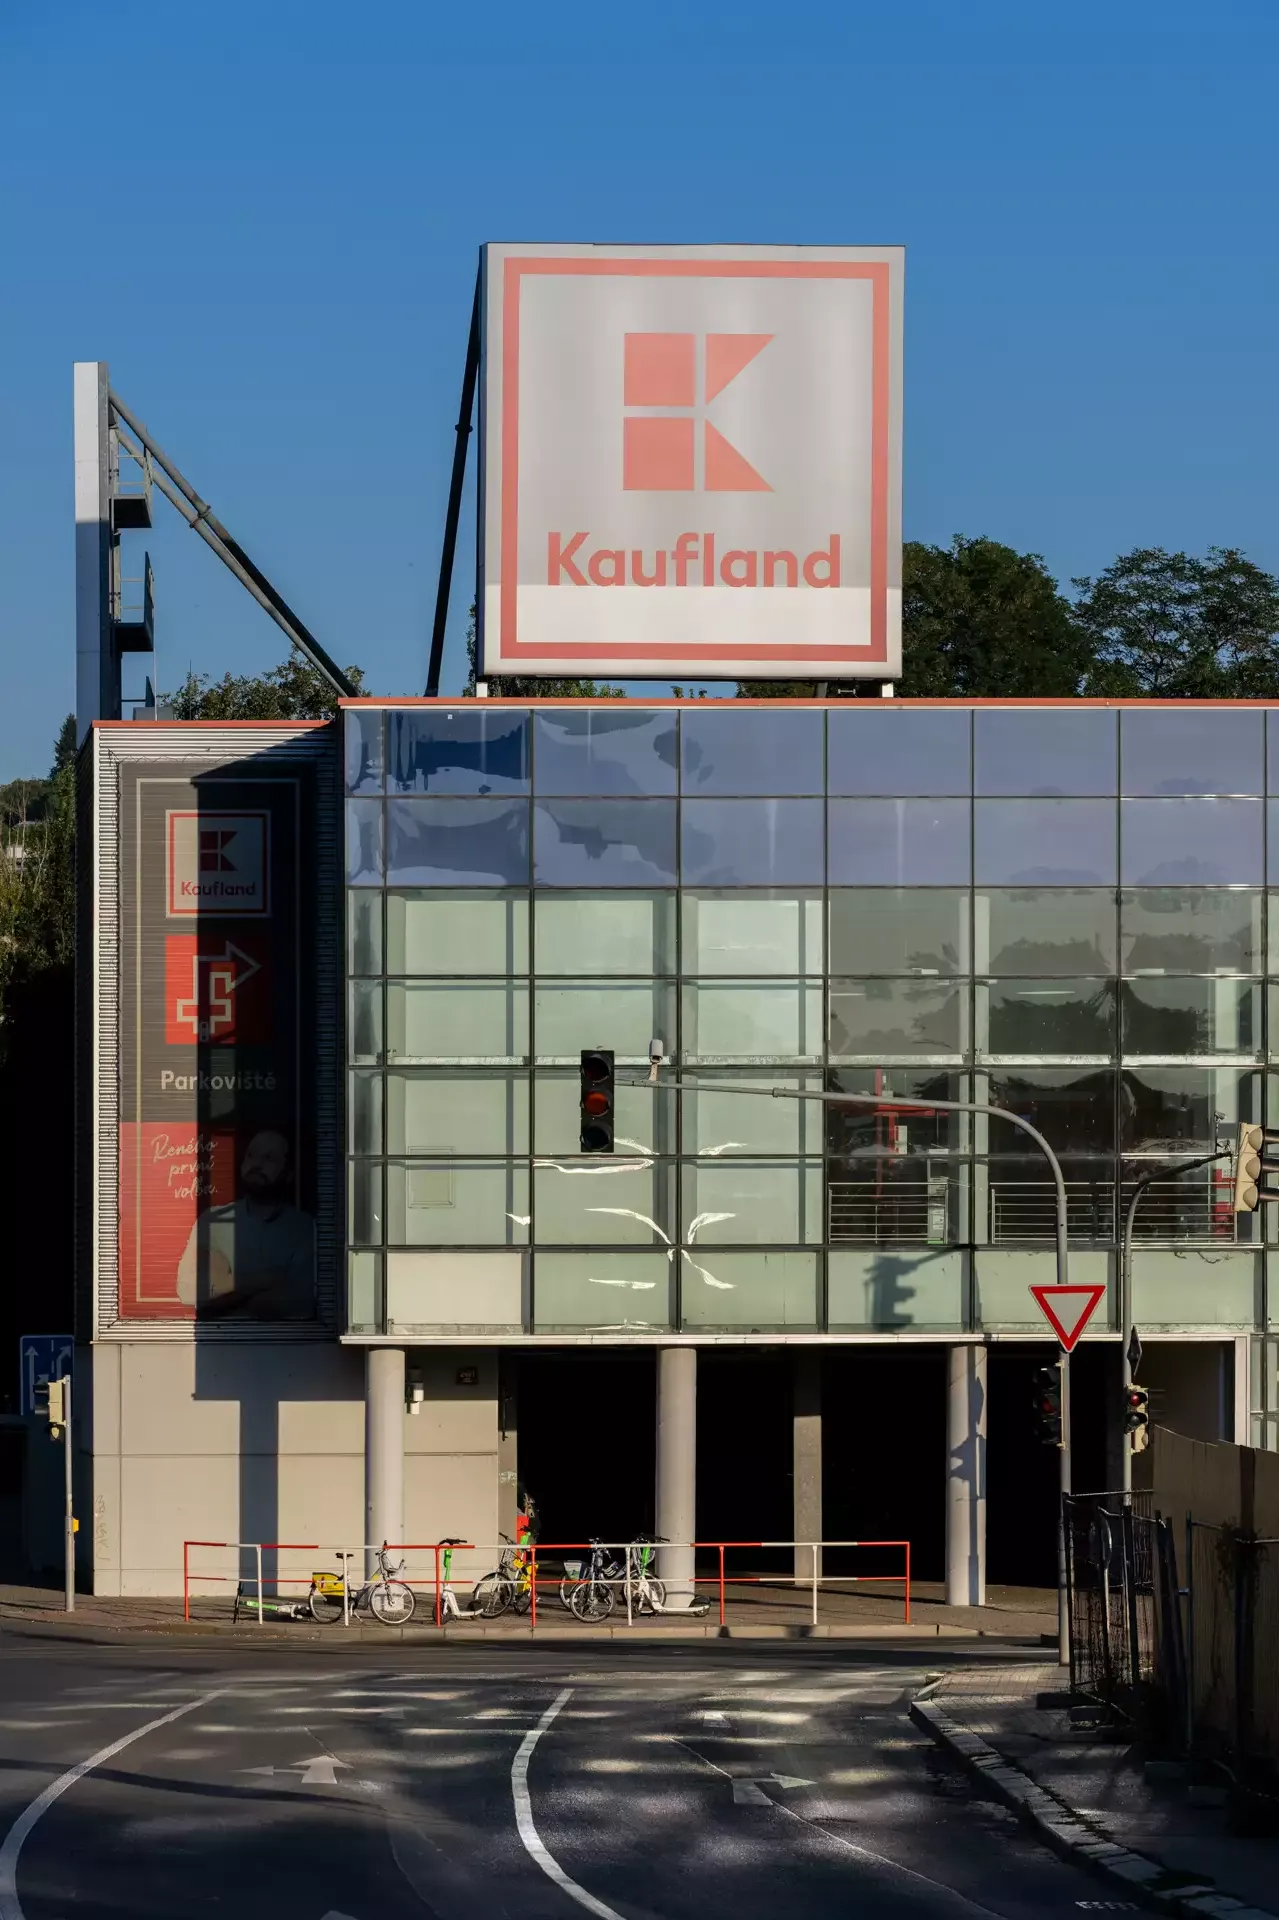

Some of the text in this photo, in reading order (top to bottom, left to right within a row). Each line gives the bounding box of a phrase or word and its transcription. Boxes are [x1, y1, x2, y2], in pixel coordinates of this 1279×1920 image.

[623, 332, 776, 492] K
[547, 531, 841, 588] Kaufland
[181, 881, 256, 896] Kaufland
[160, 1069, 277, 1091] Parkoviště
